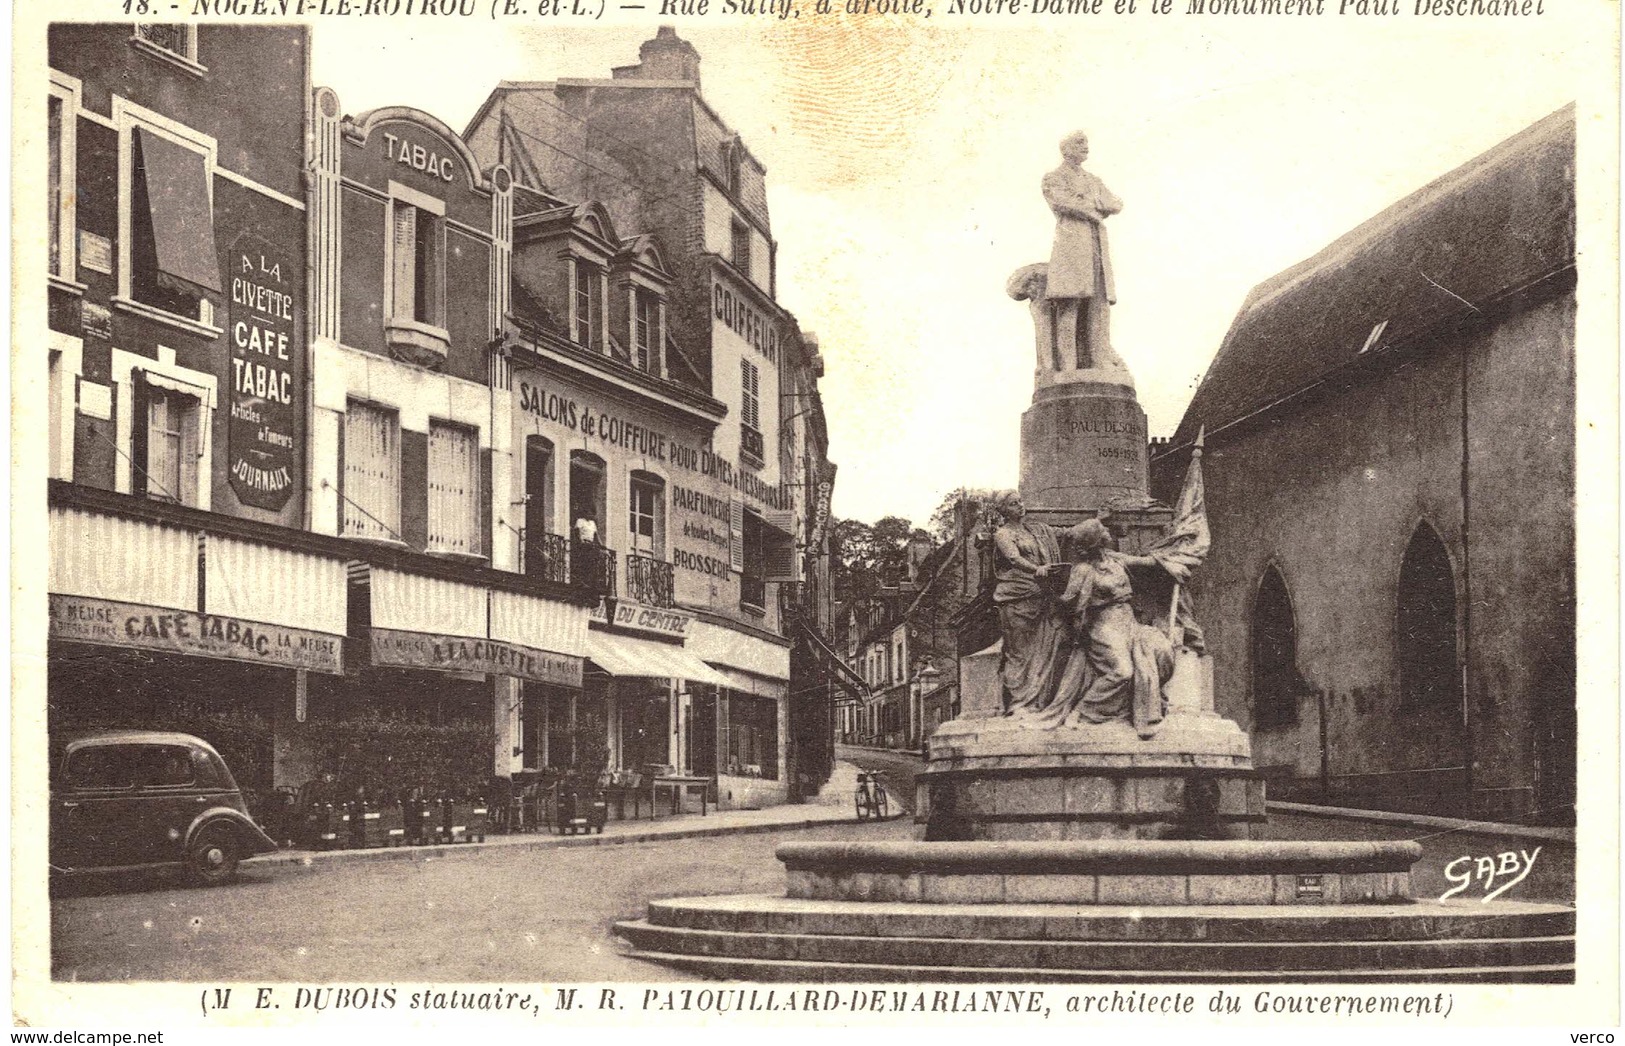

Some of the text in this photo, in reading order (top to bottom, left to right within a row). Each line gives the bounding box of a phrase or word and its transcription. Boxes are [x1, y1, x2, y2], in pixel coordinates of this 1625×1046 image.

[384, 132, 454, 182] TABAC
[241, 254, 281, 282] A LA
[232, 277, 293, 321] CIVETTE
[234, 321, 289, 361] CAFÉ
[714, 282, 777, 366] COIFFEUR
[233, 357, 292, 405] TABAC
[231, 401, 261, 424] Articles
[1070, 420, 1100, 433] PAUL
[257, 427, 265, 441] de
[520, 382, 577, 430] SALONS
[580, 406, 596, 436] de
[598, 413, 666, 460] COIFFURE
[669, 441, 698, 472] POUR
[701, 450, 732, 487] DAMES
[739, 467, 778, 510] MESSIEURS
[232, 458, 292, 491] JOURNAUX
[673, 485, 730, 524] PARFUMERIE
[683, 520, 691, 537] de
[673, 547, 730, 582] BROSSERIE
[67, 605, 113, 623] MEUSE
[616, 606, 636, 623] DU
[637, 610, 690, 633] CENTRE
[124, 612, 190, 640] CAFÉ
[197, 613, 270, 656] TABAC
[278, 633, 334, 655] LA MEUSE
[433, 644, 444, 662] A
[474, 641, 538, 675] CIVETTE
